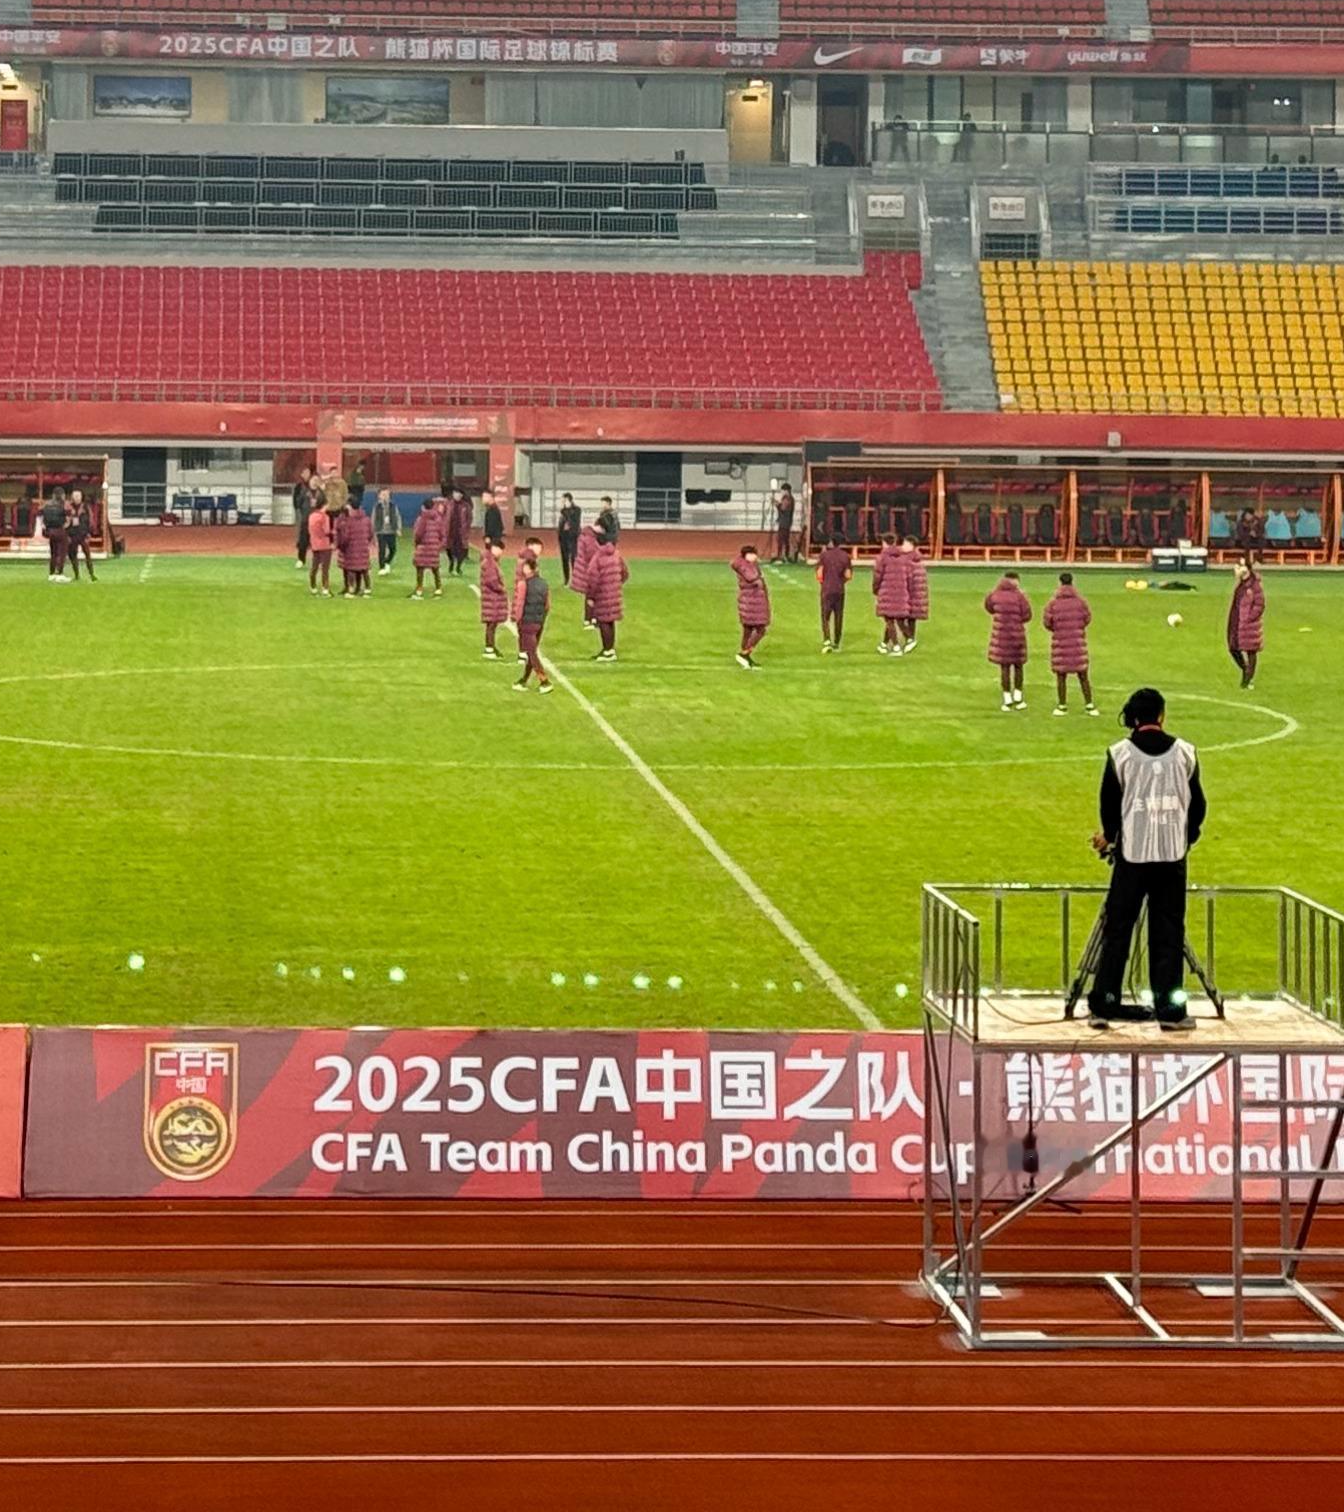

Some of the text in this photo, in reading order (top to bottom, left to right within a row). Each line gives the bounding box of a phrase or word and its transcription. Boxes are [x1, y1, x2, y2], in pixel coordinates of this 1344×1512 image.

[154, 1051, 229, 1077] CFA
[311, 1130, 407, 1174] CFA
[420, 1130, 552, 1174] Team
[566, 1130, 706, 1174] China
[721, 1132, 877, 1174] Panda
